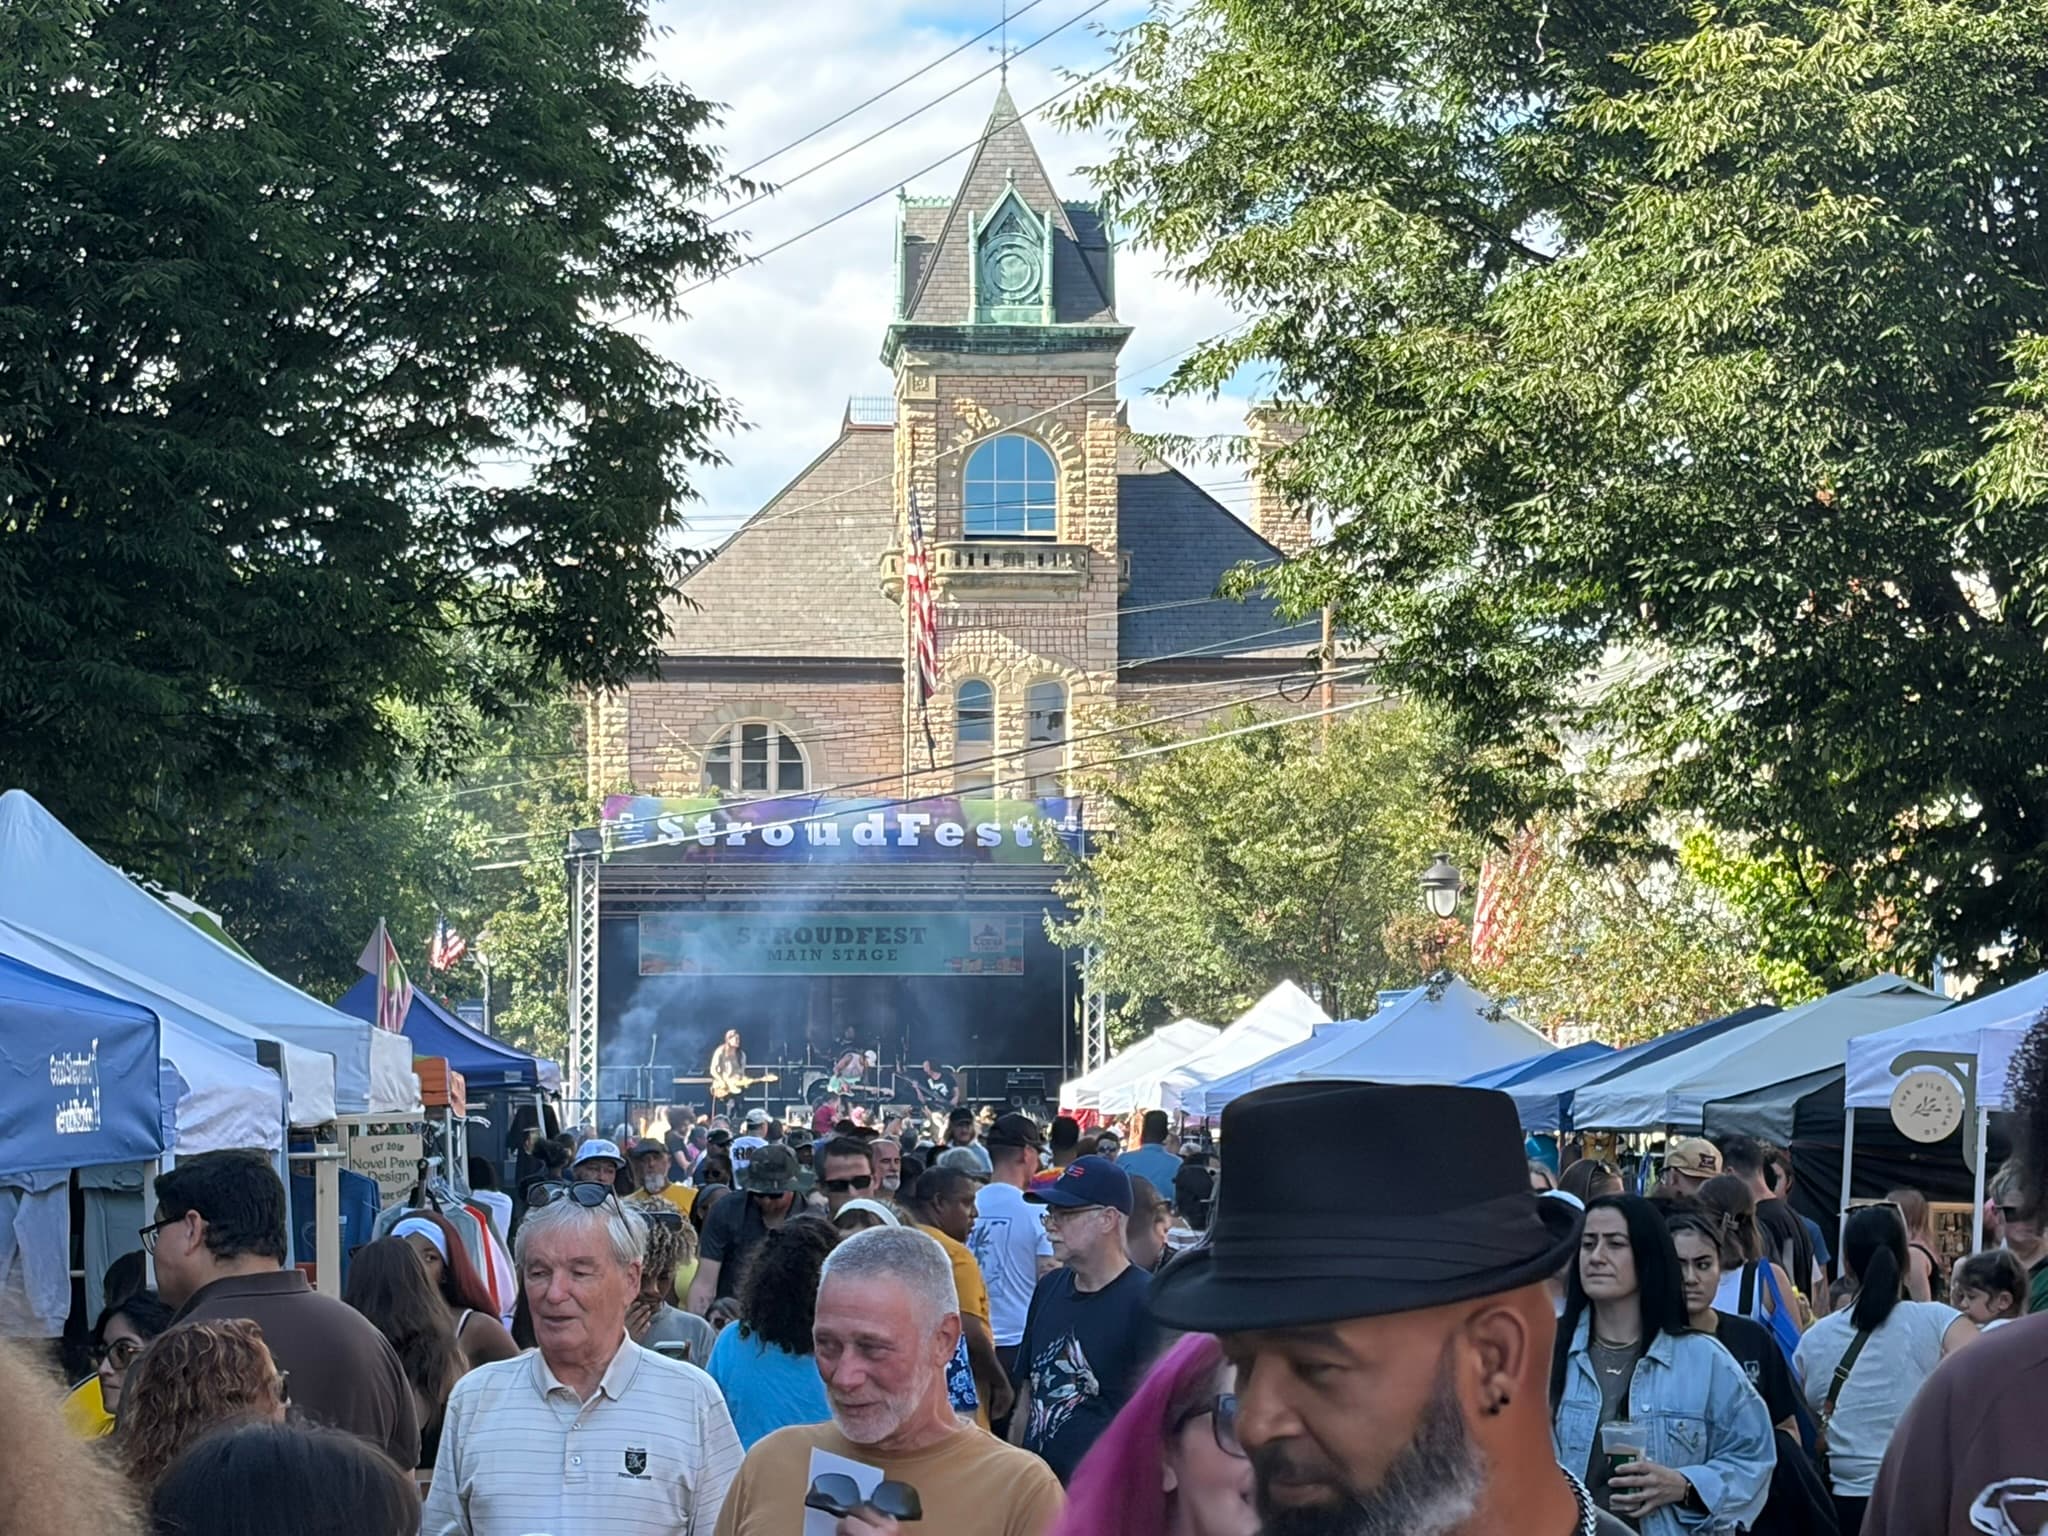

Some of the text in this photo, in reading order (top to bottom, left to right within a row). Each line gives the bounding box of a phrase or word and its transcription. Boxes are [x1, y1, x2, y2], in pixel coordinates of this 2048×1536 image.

[656, 812, 1033, 847] StroudFest
[736, 927, 927, 945] STROUDFEST
[768, 949, 898, 961] MAIN STAGE
[371, 1143, 384, 1153] EST
[353, 1156, 386, 1169] Novel
[368, 1170, 410, 1184] Design
